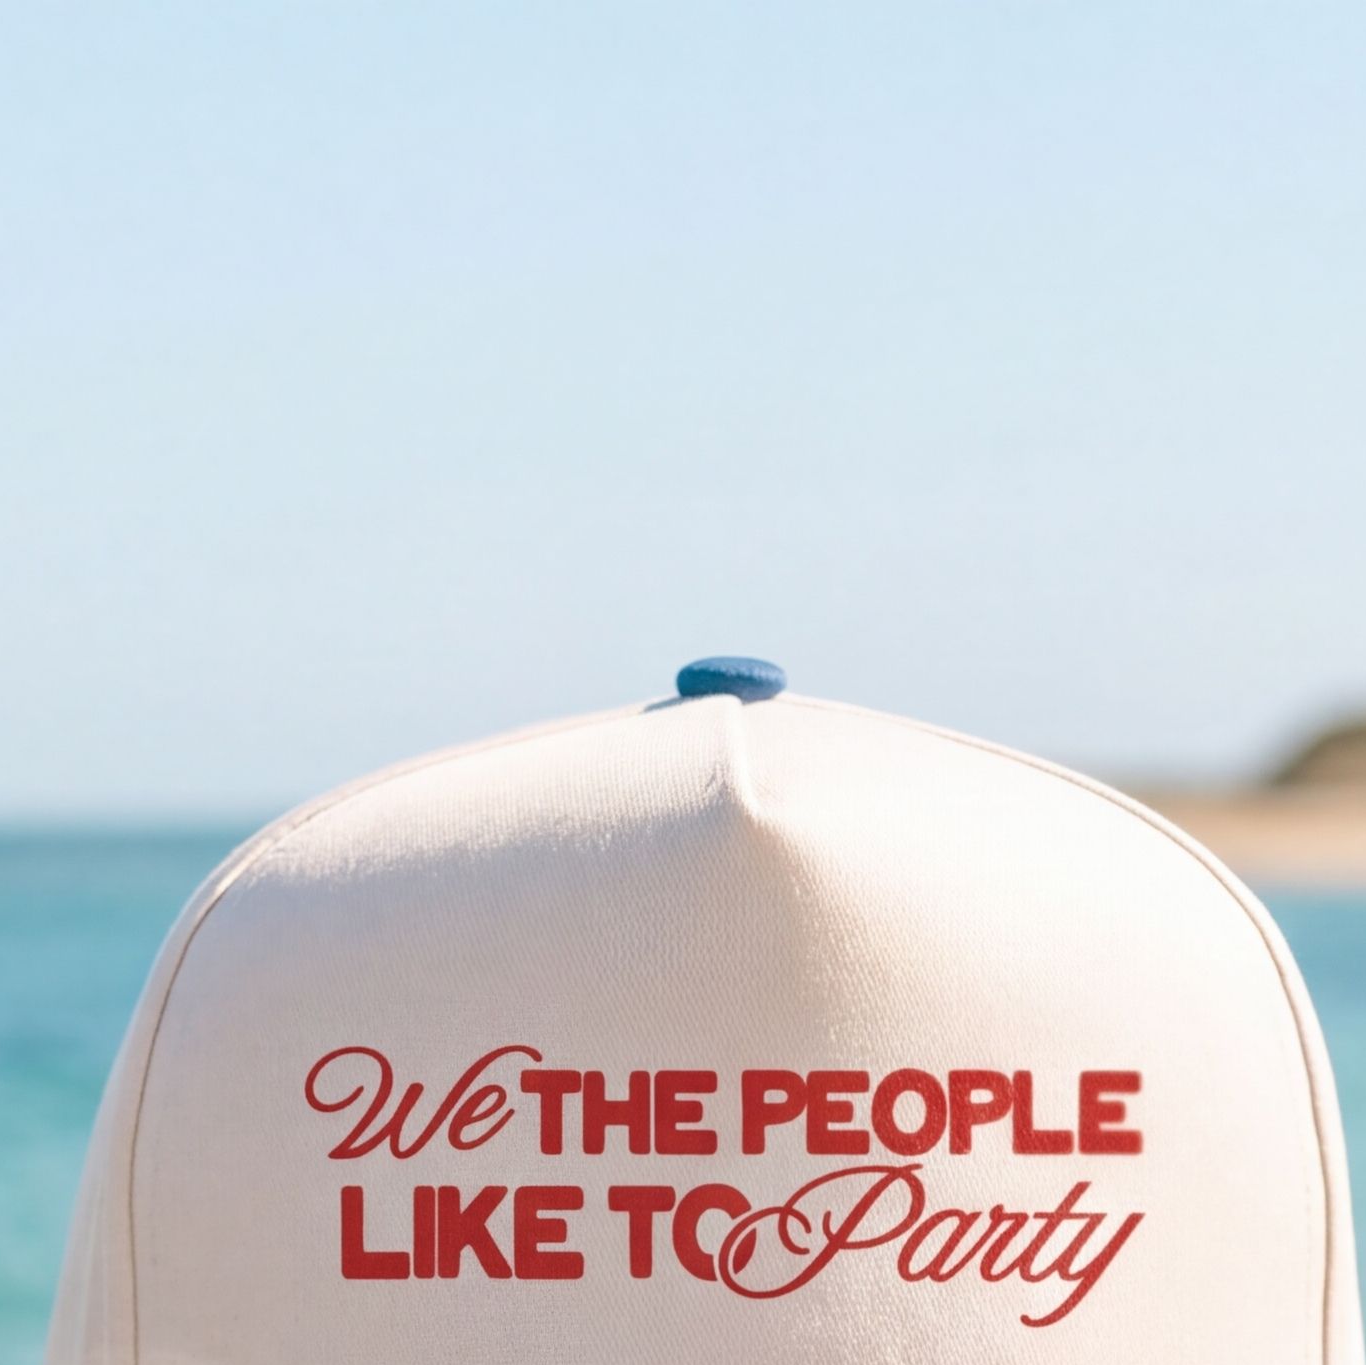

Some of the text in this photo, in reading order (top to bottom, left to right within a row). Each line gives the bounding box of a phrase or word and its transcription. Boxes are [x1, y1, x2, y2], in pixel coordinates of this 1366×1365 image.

[304, 1045, 1144, 1160] We THE PEOPLE
[341, 1162, 1145, 1329] LIKE TO Party
